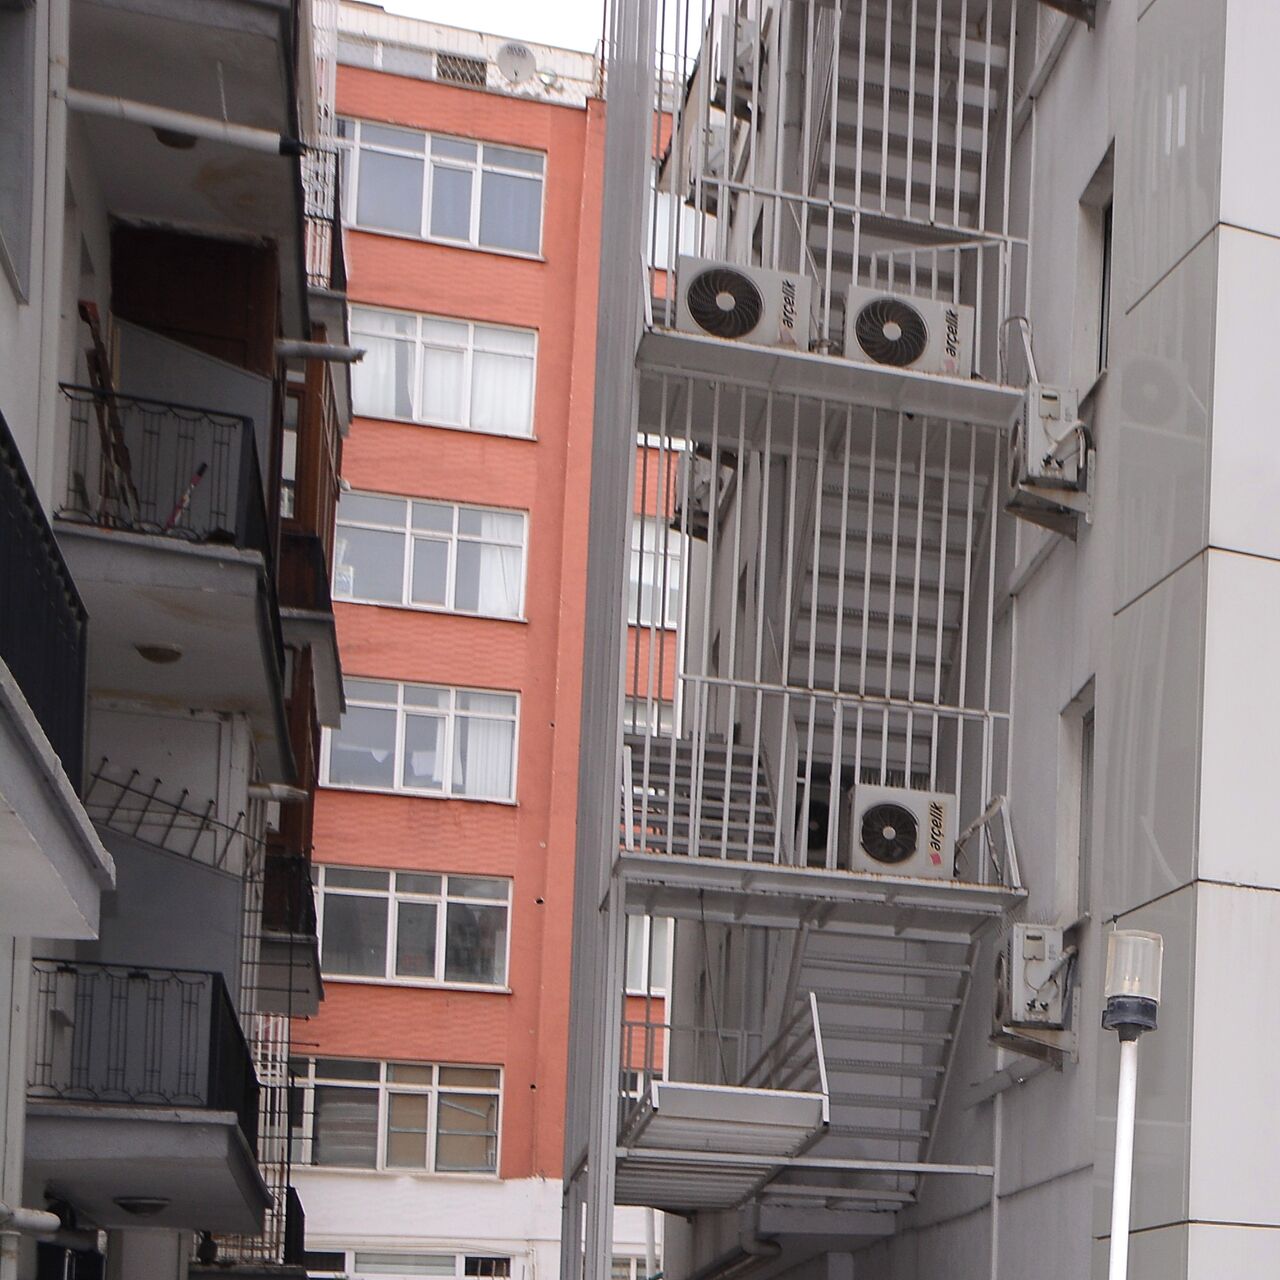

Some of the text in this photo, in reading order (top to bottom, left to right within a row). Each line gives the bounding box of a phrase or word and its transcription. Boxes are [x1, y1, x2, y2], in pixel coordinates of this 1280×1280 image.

[782, 279, 797, 329] arçelik
[945, 309, 960, 357] arçelik
[930, 801, 945, 851] arçelik
